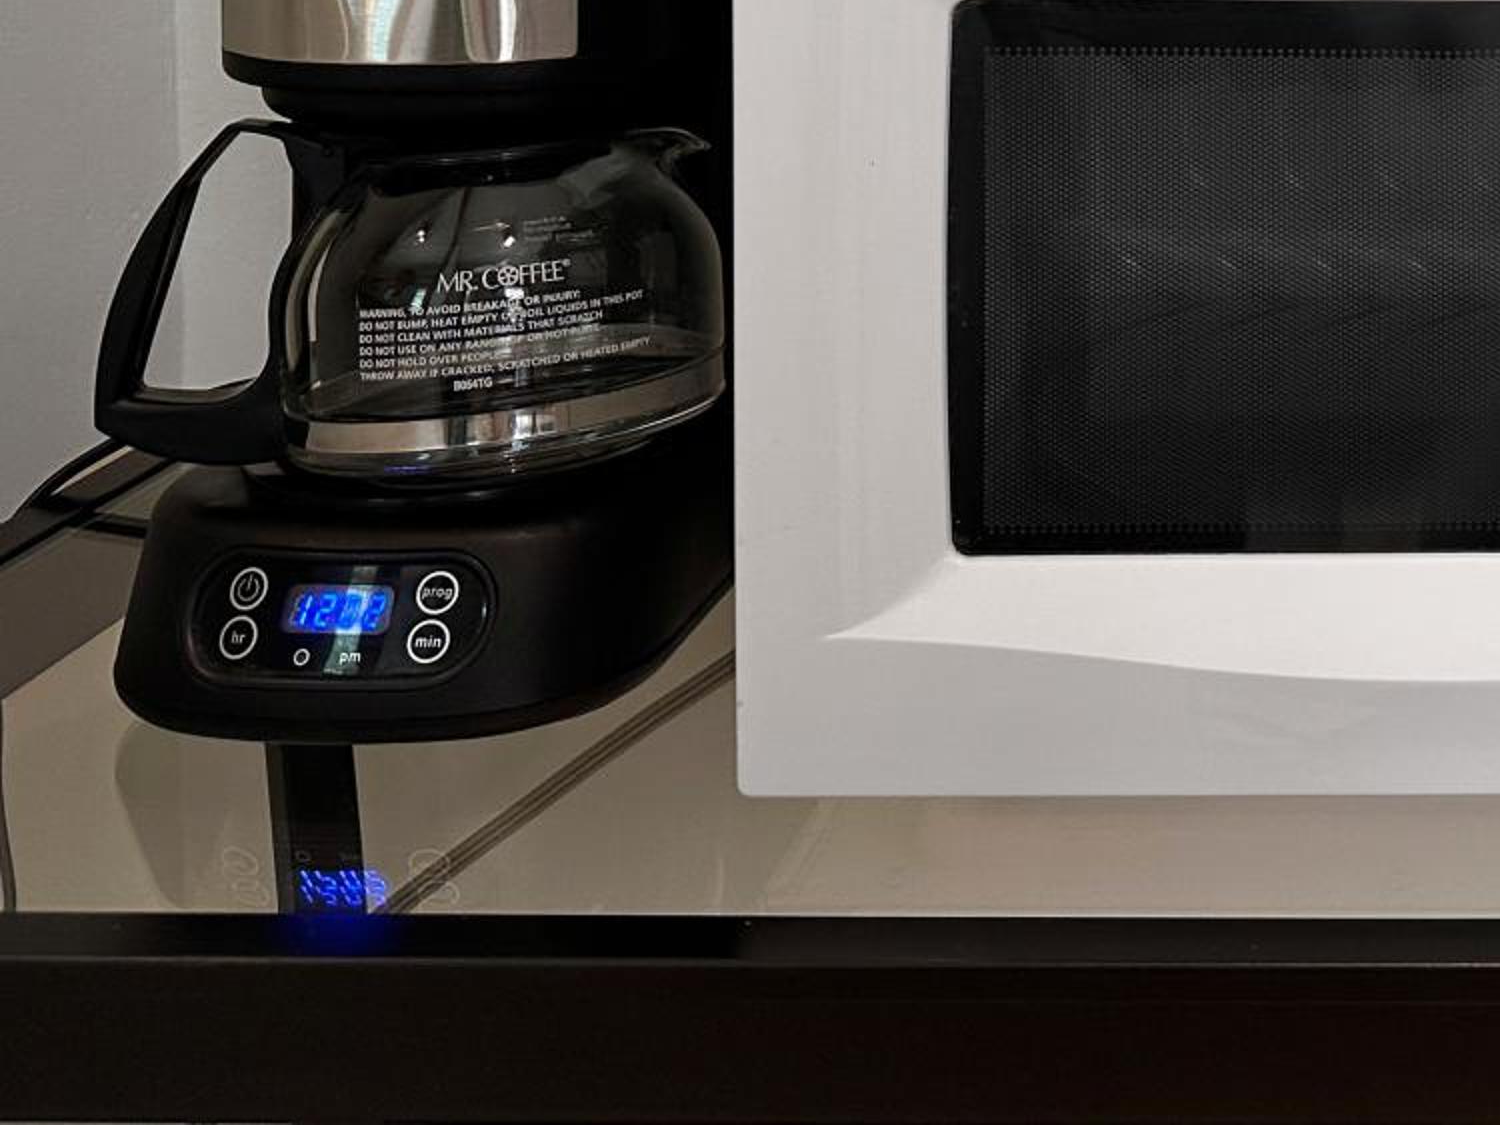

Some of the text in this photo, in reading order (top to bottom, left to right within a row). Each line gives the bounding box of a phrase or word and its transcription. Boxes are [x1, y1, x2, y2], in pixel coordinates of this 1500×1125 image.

[437, 260, 565, 292] MR. COFFEE
[360, 321, 373, 331] DO
[375, 321, 395, 331] NOT
[431, 317, 458, 328] HEAT
[461, 313, 499, 325] EMPTY
[547, 300, 589, 315] LIQUIDS
[590, 298, 601, 308] IN
[625, 289, 644, 301] POT
[426, 304, 460, 315] AVOID
[524, 296, 540, 306] OR
[360, 334, 373, 344] DO
[375, 333, 395, 343] NOT
[397, 332, 431, 343] CLEAN
[433, 330, 461, 339] WITH
[528, 320, 555, 329] THAT
[360, 346, 373, 356] DO
[375, 346, 395, 356] NOT
[398, 345, 417, 354] USE
[419, 343, 436, 353] ON
[438, 342, 461, 351] ANY
[360, 359, 374, 368] DO
[375, 358, 396, 368] NOT
[398, 356, 426, 367] HOLD
[429, 355, 458, 365] OVER
[361, 371, 394, 380] THROW
[422, 585, 453, 600] prog
[231, 630, 245, 645] hr
[415, 634, 441, 648] min
[339, 652, 361, 665] pm
